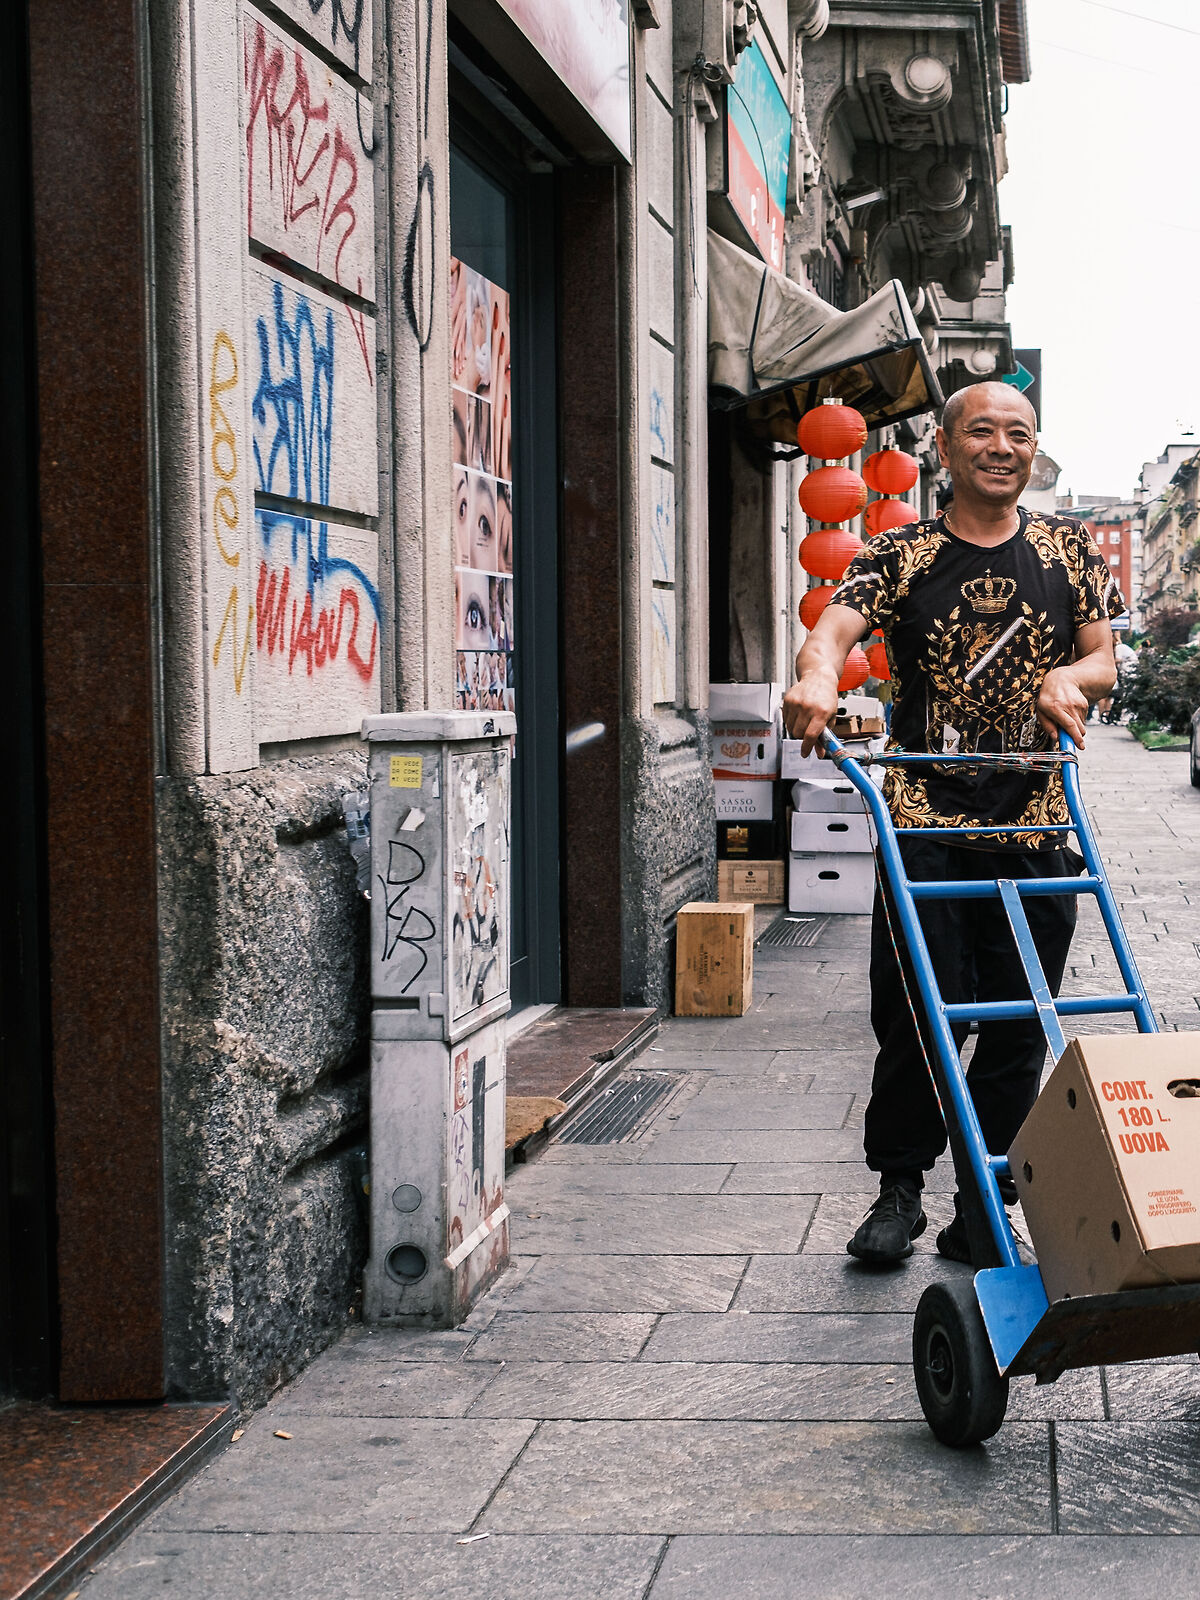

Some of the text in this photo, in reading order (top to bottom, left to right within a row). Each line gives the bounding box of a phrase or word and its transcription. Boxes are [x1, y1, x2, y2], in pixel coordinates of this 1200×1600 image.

[714, 728, 771, 737] AIR DRIED GINGER
[721, 798, 753, 806] SASSO
[1101, 1080, 1153, 1102] CONT.
[1117, 1106, 1154, 1127] 180
[1118, 1131, 1170, 1154] UOVA
[1147, 1209, 1164, 1217] DOPO
